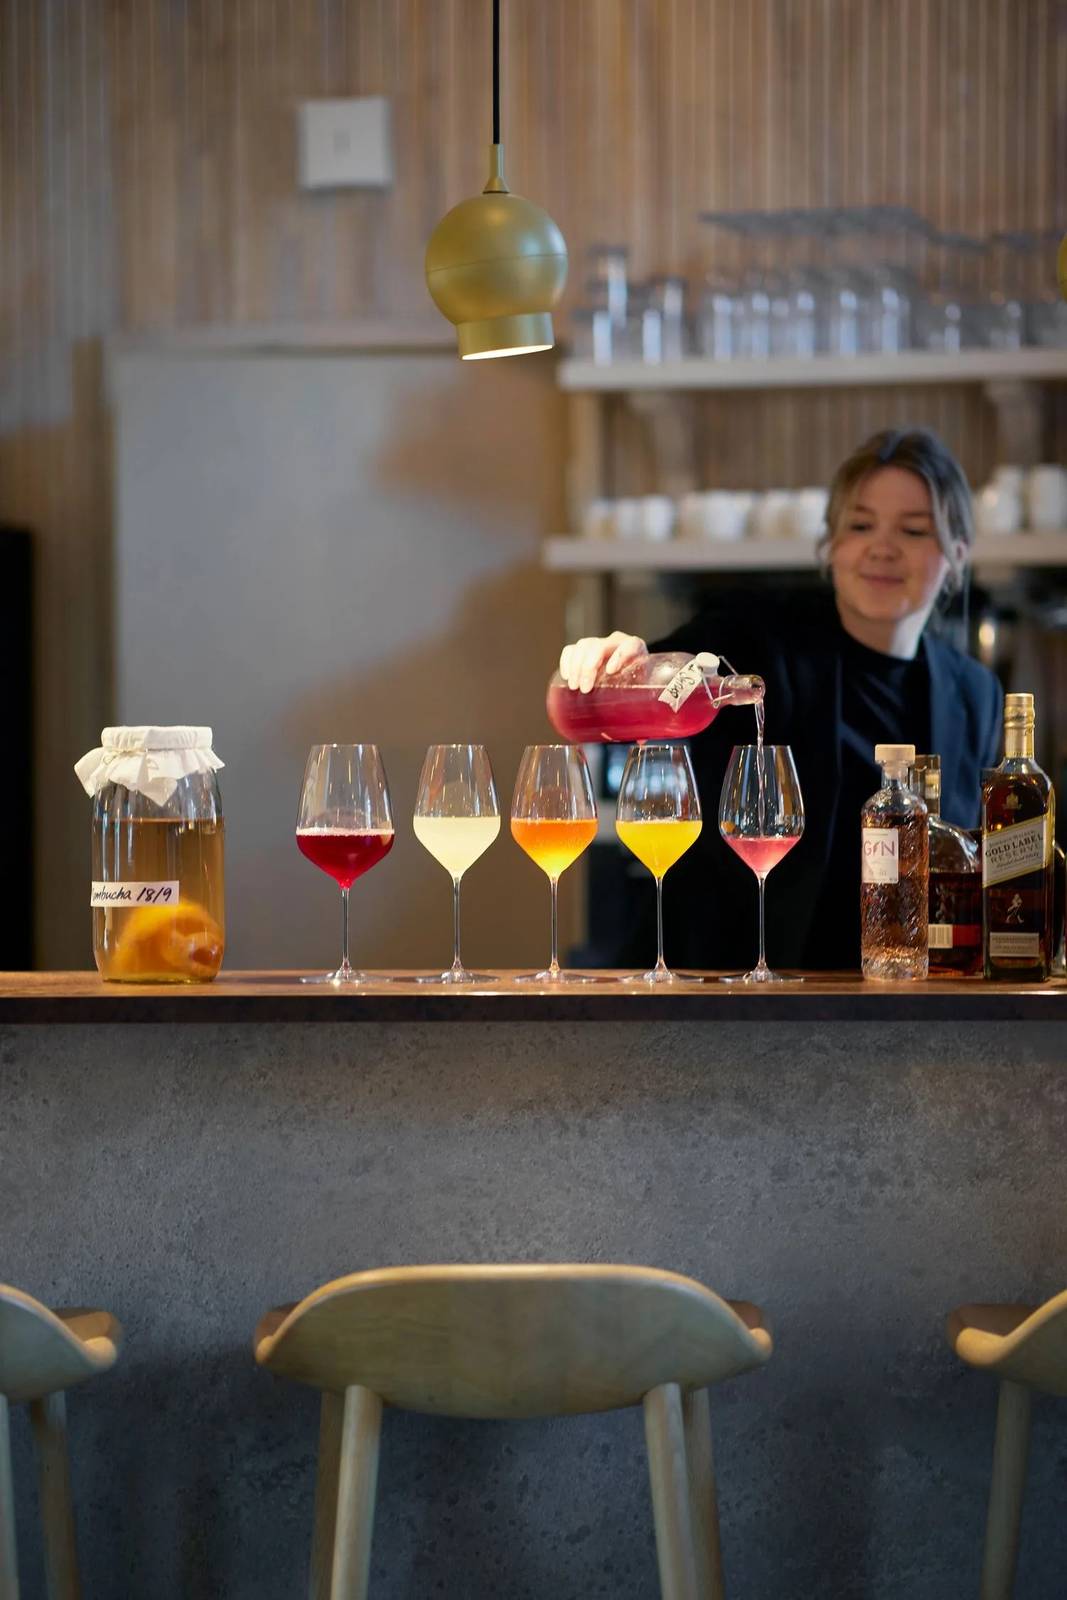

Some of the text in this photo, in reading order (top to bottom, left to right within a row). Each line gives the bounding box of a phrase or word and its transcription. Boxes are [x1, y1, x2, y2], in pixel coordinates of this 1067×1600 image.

[985, 843, 1010, 858] GOLD
[1012, 833, 1043, 849] LABEL
[136, 887, 172, 903] 18/9
